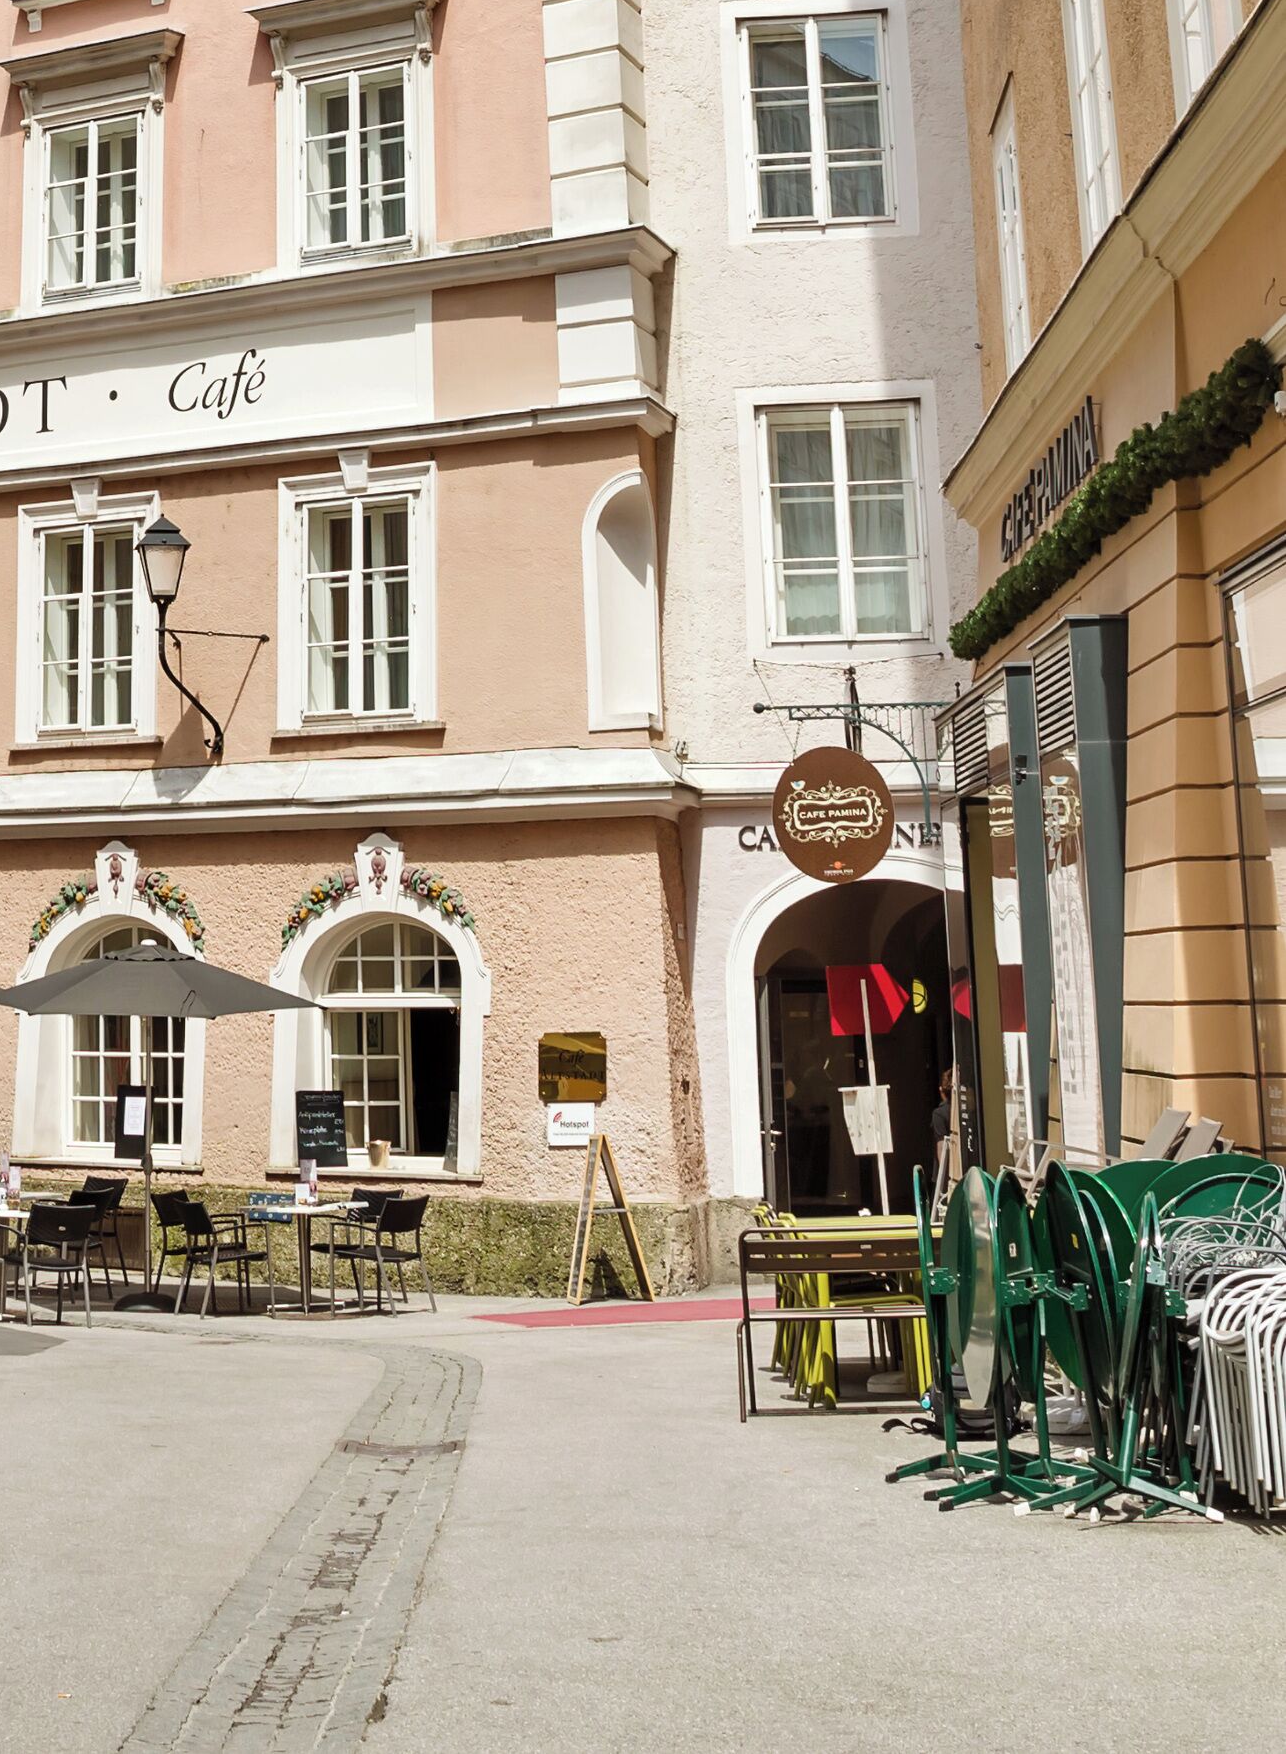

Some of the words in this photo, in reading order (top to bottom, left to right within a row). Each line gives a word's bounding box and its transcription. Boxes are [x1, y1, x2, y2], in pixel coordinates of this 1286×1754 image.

[168, 348, 266, 420] Café
[1035, 395, 1100, 527] PAMINA
[798, 810, 826, 819] CAFE
[828, 808, 867, 818] PAMINA
[560, 1120, 590, 1130] Hotspot
